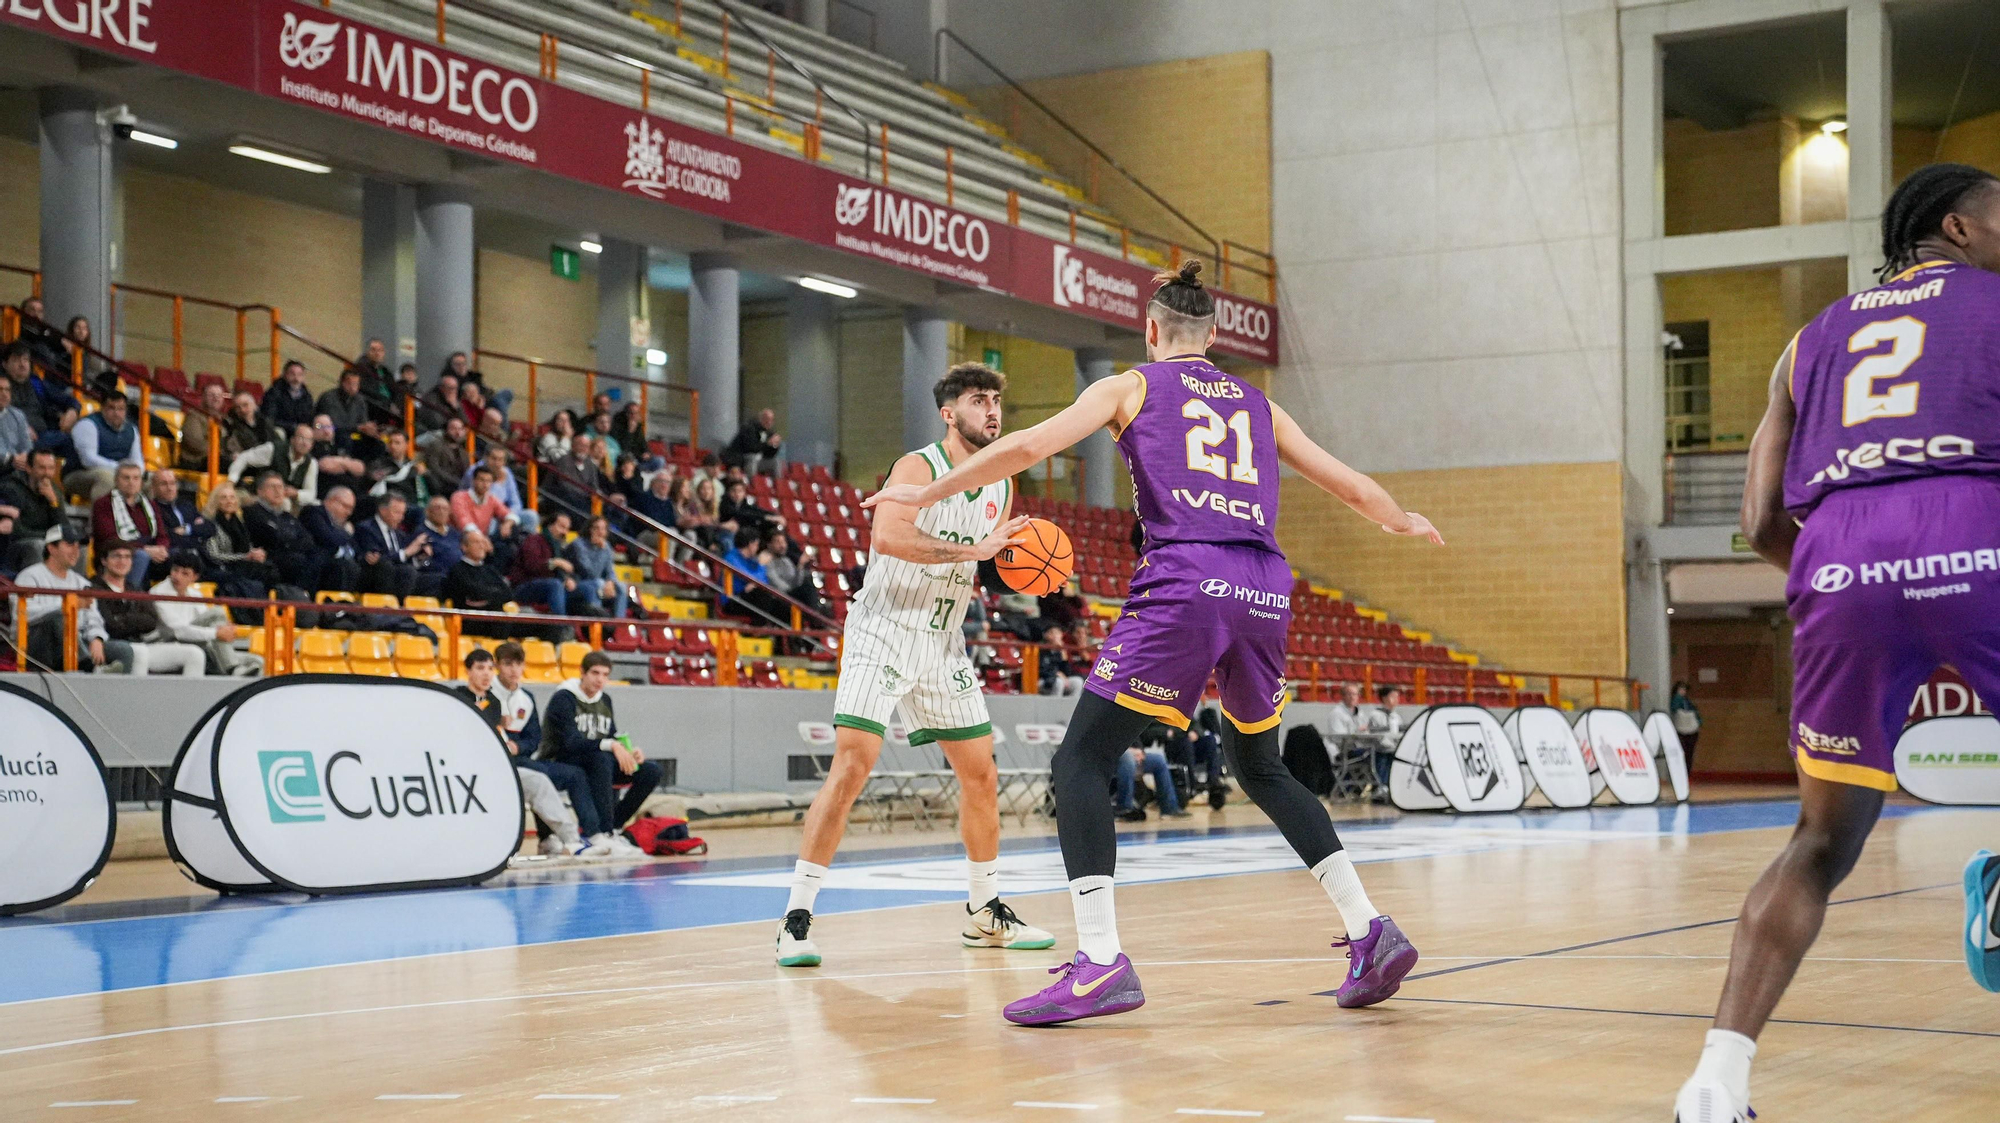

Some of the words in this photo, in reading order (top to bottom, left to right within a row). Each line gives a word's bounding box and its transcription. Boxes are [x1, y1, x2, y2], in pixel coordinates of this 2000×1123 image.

[346, 26, 538, 133] IMDECO
[280, 75, 339, 109] Instituto
[341, 91, 408, 127] Municipal
[409, 111, 427, 132] de
[428, 117, 485, 149] Deportes
[666, 137, 741, 180] AYUNTAMIENTO
[666, 164, 680, 190] DE
[873, 189, 990, 263] IMDECO
[1085, 266, 1138, 299] Diputación
[1850, 278, 1945, 311] HANNA
[1214, 297, 1270, 341] MDECO
[1180, 372, 1244, 399] ARQUÉS
[1842, 315, 1927, 427] 2
[1182, 398, 1259, 485] 21
[1171, 489, 1266, 526] IVECO
[1860, 548, 2000, 585] HYUNDA
[1234, 585, 1290, 611] HYUNDA
[1903, 582, 1971, 600] Hyupersa
[929, 596, 956, 631] 27
[1248, 607, 1281, 621] Hyupersa
[1097, 656, 1119, 676] CBC
[0, 751, 58, 776] lucía
[1908, 753, 1954, 763] SAN
[1958, 753, 2000, 763] SEB
[324, 750, 488, 820] Cualix
